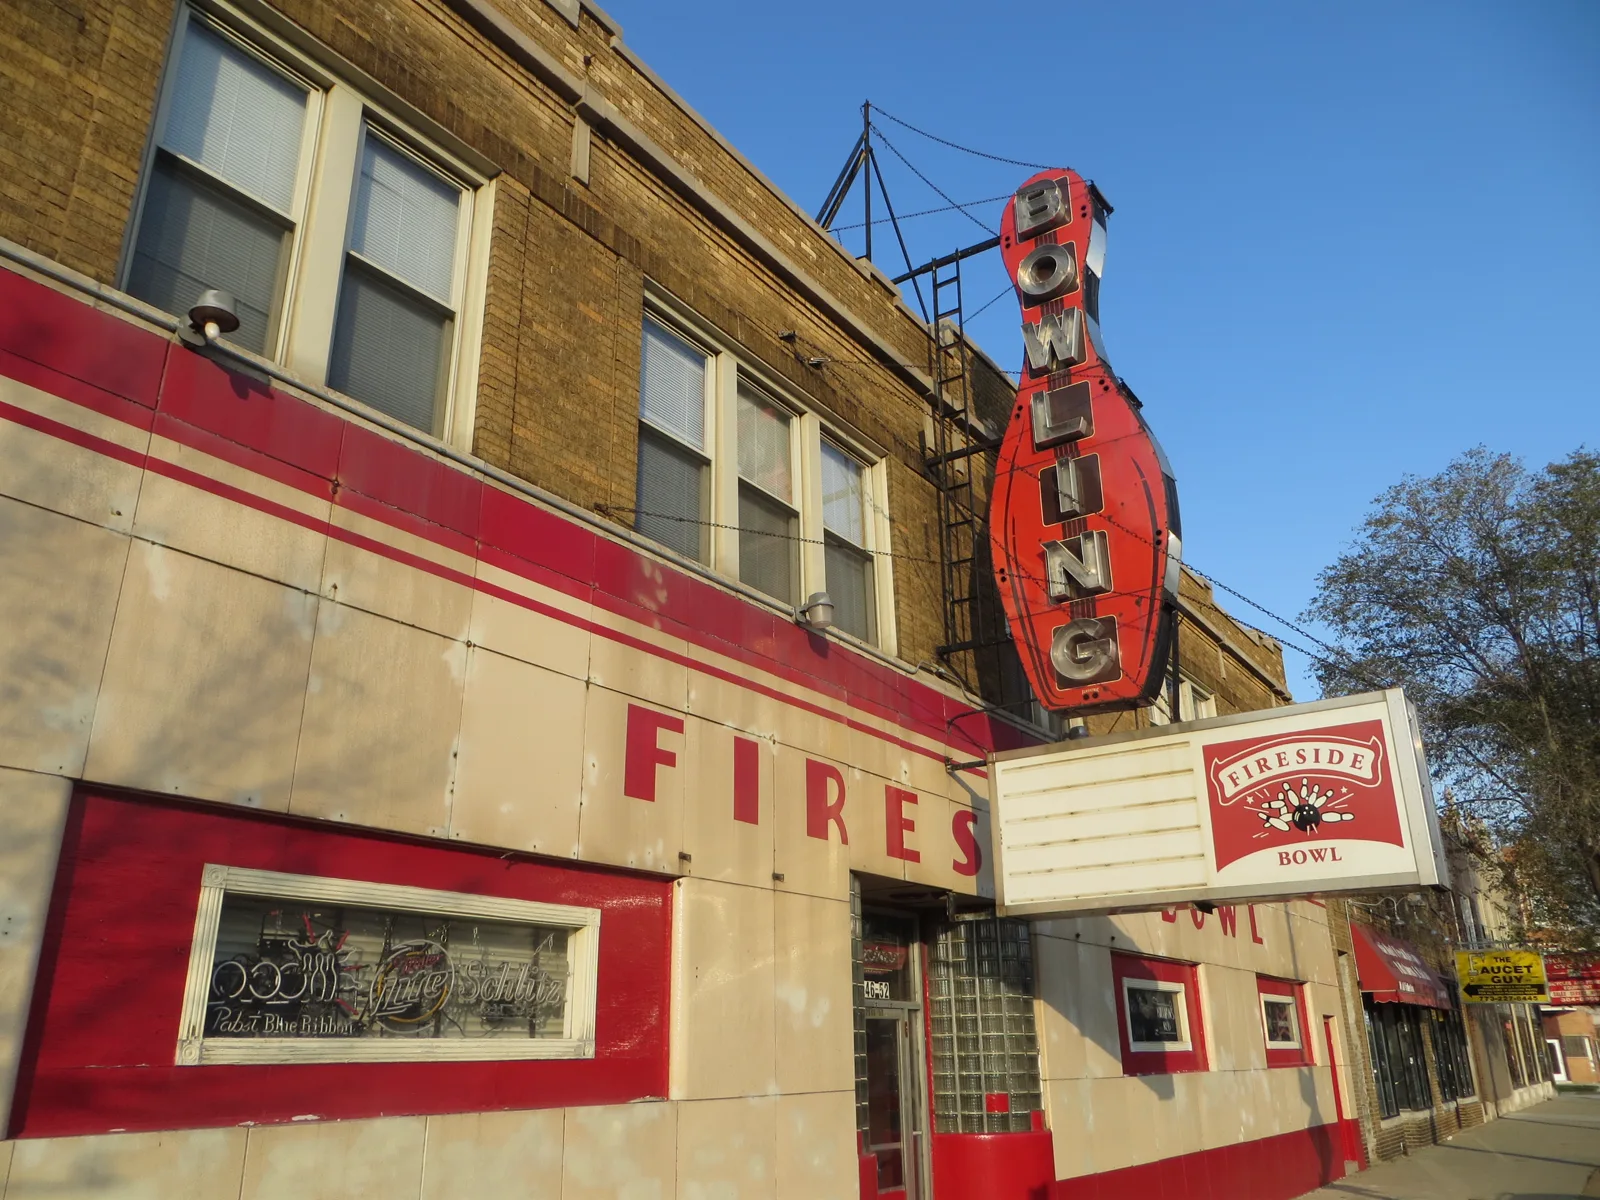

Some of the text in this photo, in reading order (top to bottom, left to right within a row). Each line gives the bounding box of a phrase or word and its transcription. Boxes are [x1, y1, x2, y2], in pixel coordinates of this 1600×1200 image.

[1014, 178, 1117, 682] BOWLING
[1227, 748, 1366, 788] FIRESIDE
[1277, 847, 1342, 867] BOWL
[1161, 903, 1264, 945] WL
[459, 959, 563, 1002] Schlitz
[865, 981, 889, 999] 46-52
[1491, 975, 1524, 984] GUY
[212, 1006, 354, 1035] Pabst Blue Ribbon
